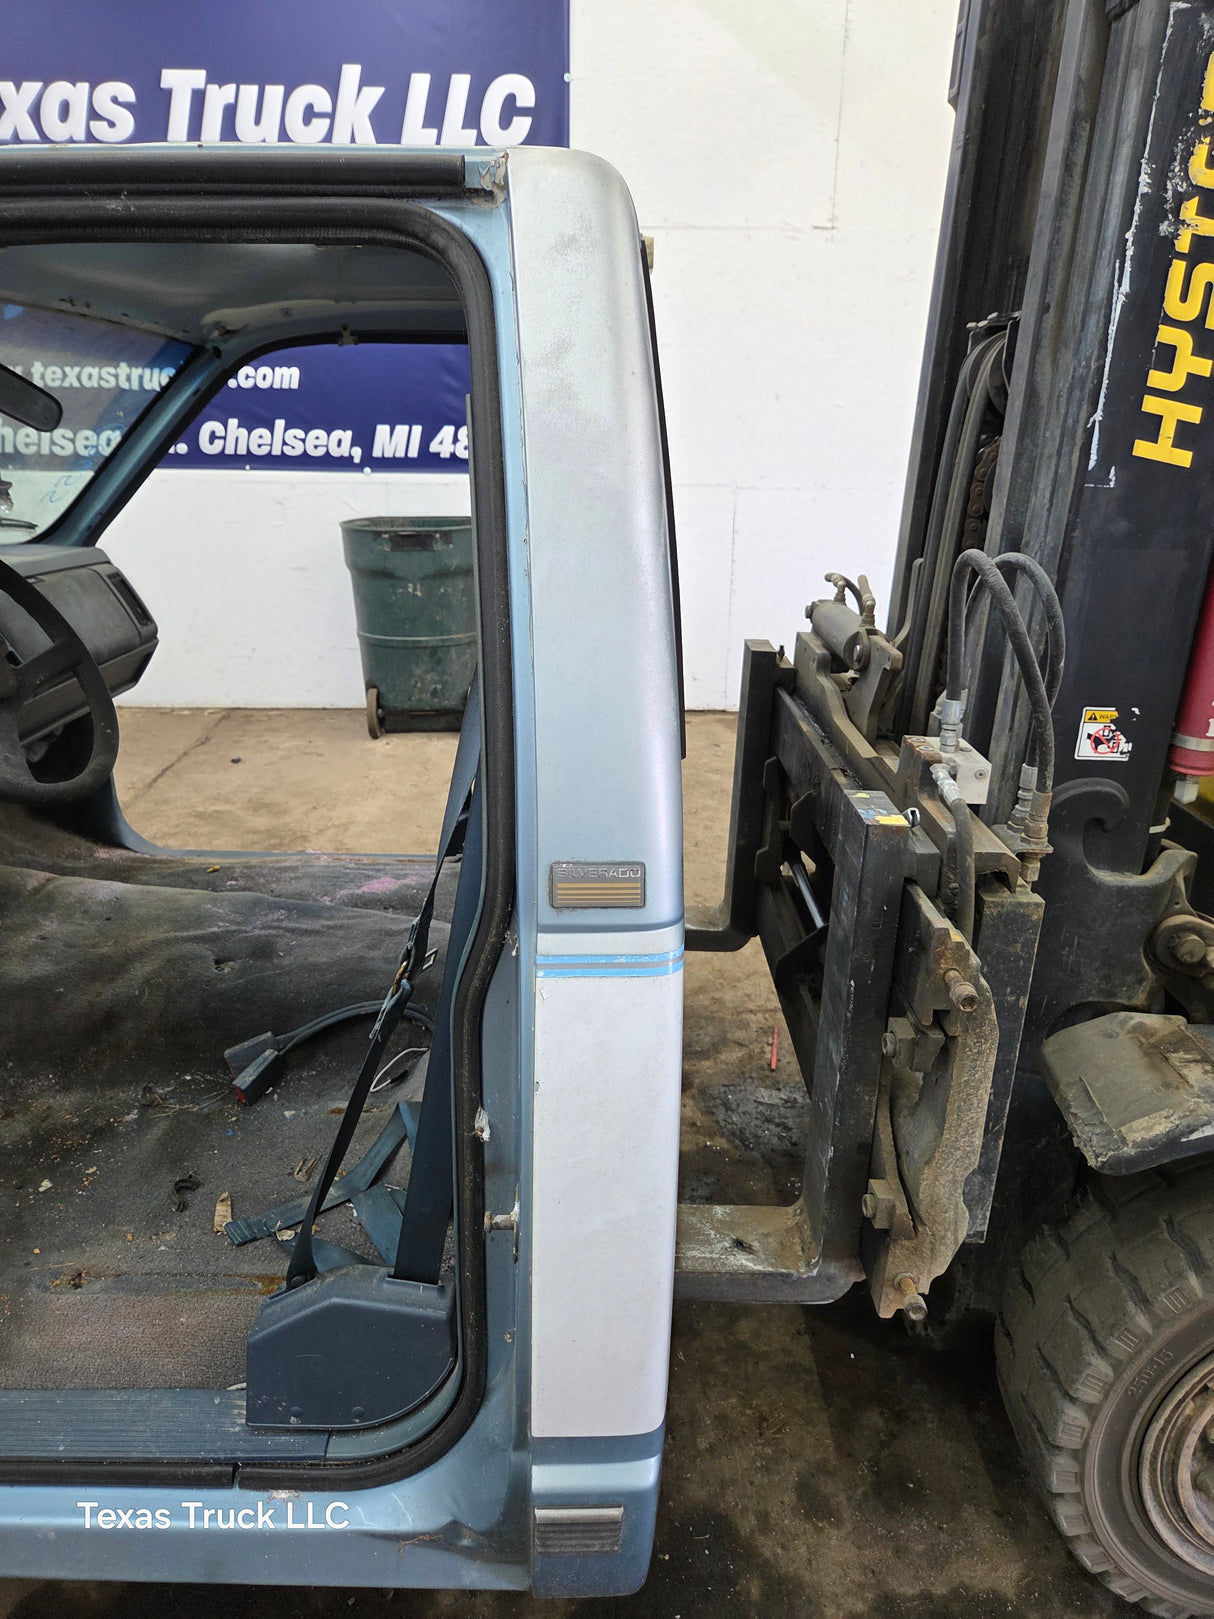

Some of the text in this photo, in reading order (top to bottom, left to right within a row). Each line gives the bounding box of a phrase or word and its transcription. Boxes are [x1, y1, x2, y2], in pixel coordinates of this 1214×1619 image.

[0, 63, 536, 146] xas Truck LLC
[1132, 50, 1214, 469] HYST
[199, 418, 362, 464] Chelsea,
[372, 424, 422, 458] MI
[557, 868, 641, 878] SILVERADO
